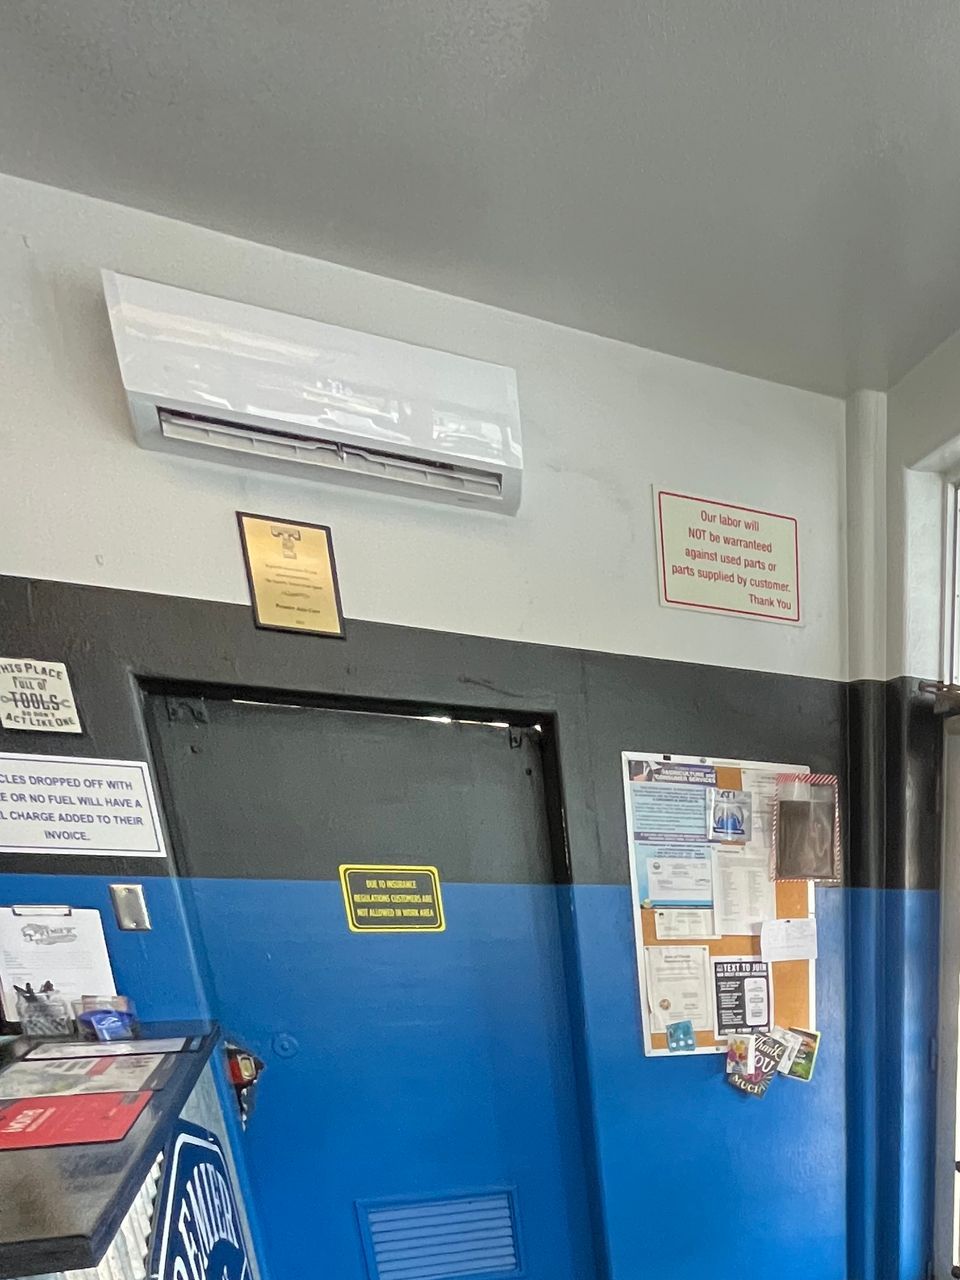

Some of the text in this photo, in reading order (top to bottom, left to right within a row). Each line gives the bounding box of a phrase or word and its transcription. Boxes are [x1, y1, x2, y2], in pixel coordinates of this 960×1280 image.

[700, 510, 760, 532] Our labor will
[688, 527, 772, 553] NOT be warranteed
[685, 547, 776, 572] against used parts or
[671, 564, 791, 592] parts supplied by customer.
[748, 593, 792, 610] Thank You
[0, 663, 63, 680] HIS PLACE
[12, 676, 47, 691] FULL OF
[8, 691, 60, 711] TOOLS
[6, 713, 76, 727] ACT LIKE ONE
[29, 776, 81, 788] DROPPED
[84, 778, 104, 789] OFF
[107, 780, 133, 791] WITH
[10, 793, 27, 803] OR
[29, 794, 46, 804] NO
[49, 795, 76, 806] FUEL
[79, 797, 105, 807] WILL
[105, 798, 133, 809] HAVE
[135, 800, 143, 809] A
[9, 811, 55, 823] CHARGE
[58, 814, 95, 824] ADDED
[97, 815, 111, 825] TO
[113, 815, 144, 826] THEIR
[44, 830, 91, 842] INVOICE.
[723, 963, 740, 972] TEXT
[742, 963, 751, 972] TO
[733, 1075, 764, 1094] MUCH
